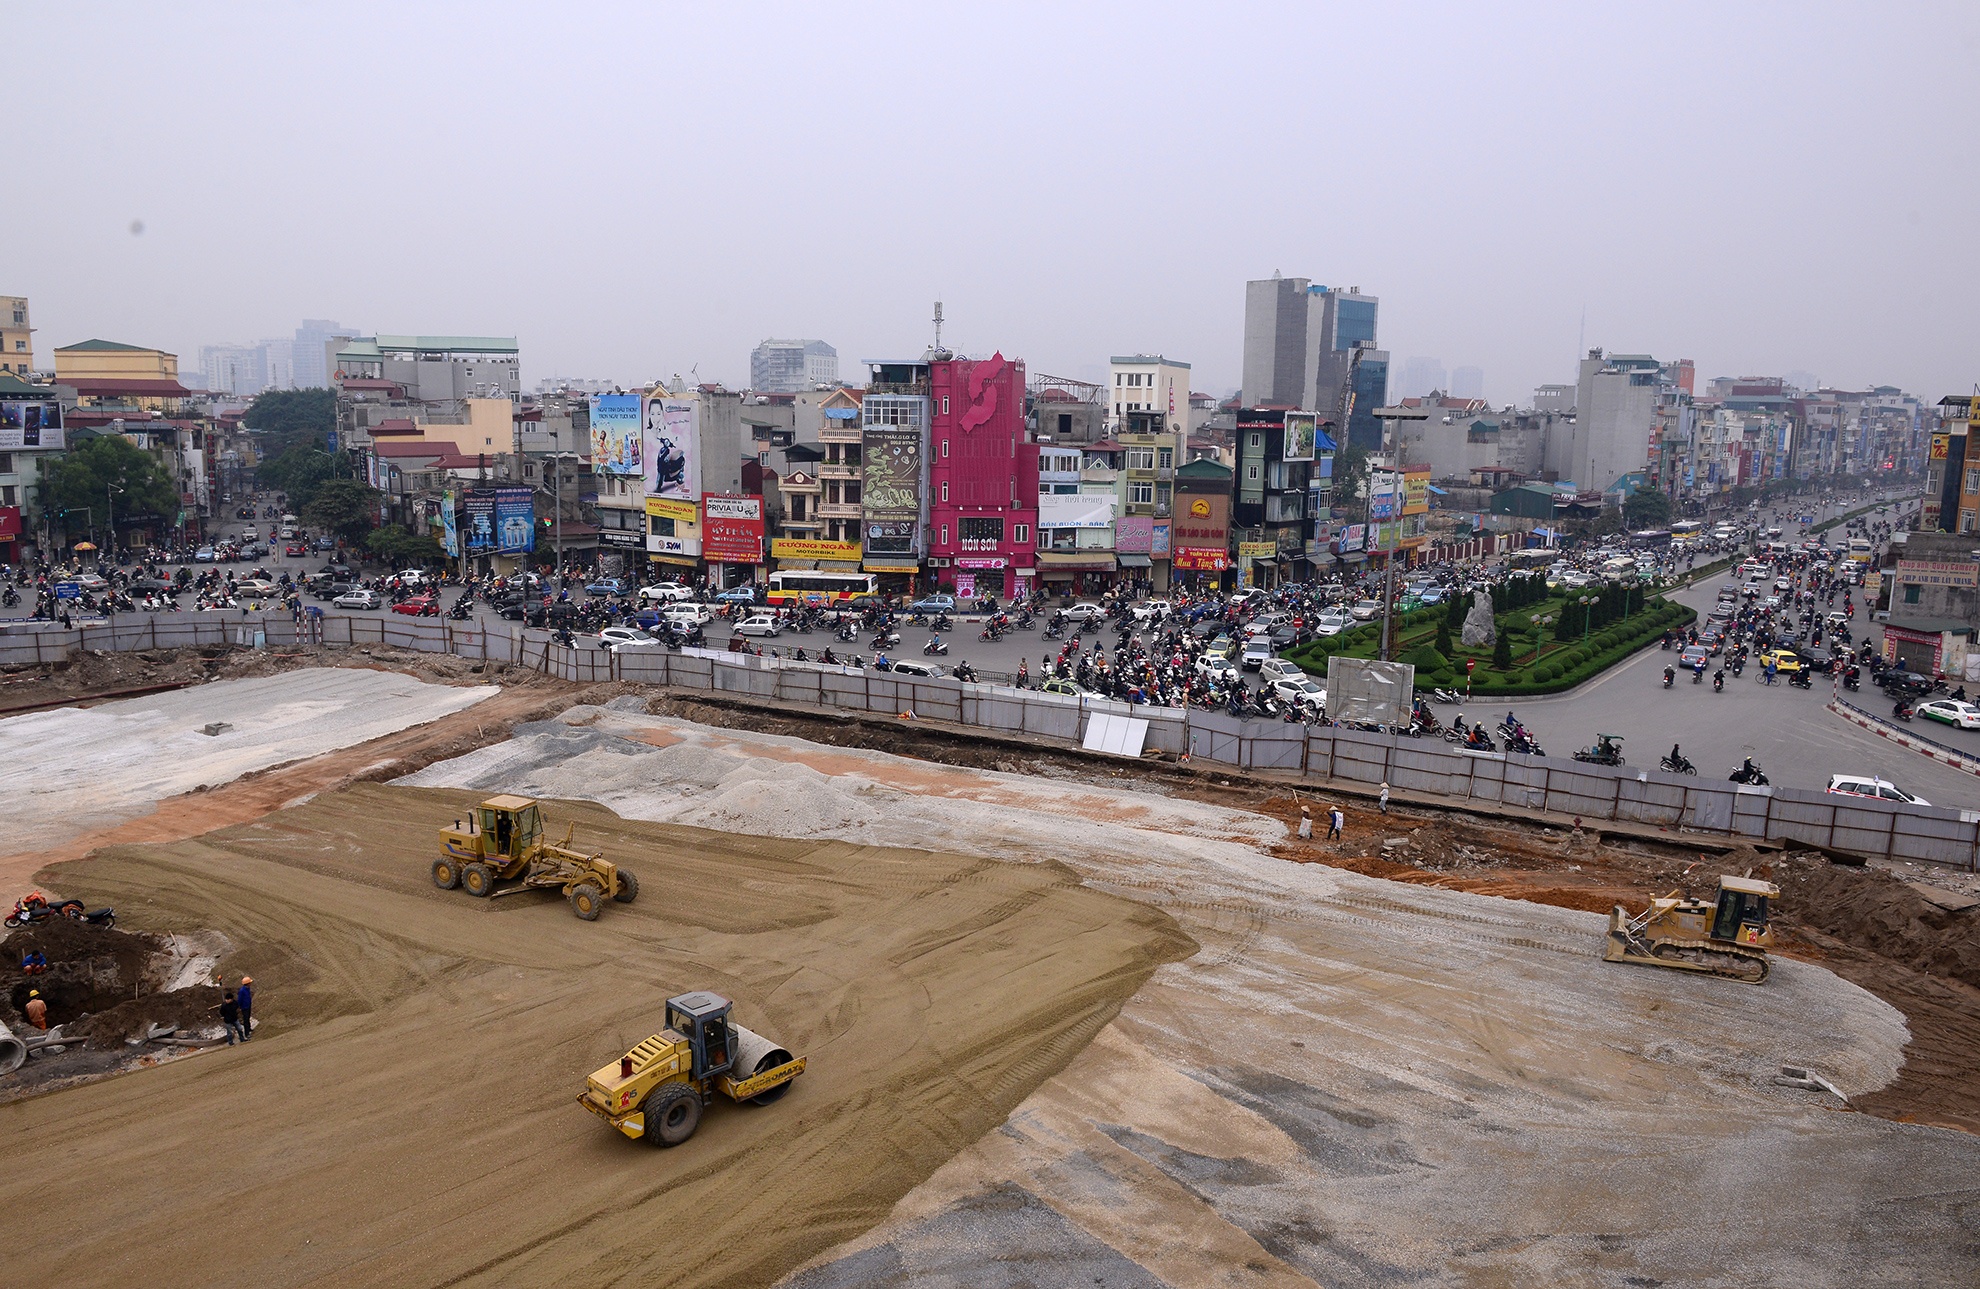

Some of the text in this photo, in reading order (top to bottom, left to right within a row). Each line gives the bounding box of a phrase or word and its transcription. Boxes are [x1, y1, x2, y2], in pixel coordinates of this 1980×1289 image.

[666, 542, 681, 550] SYM
[962, 535, 997, 551] NÓN SƠN
[1177, 558, 1190, 567] Mua
[1192, 558, 1196, 567] 2
